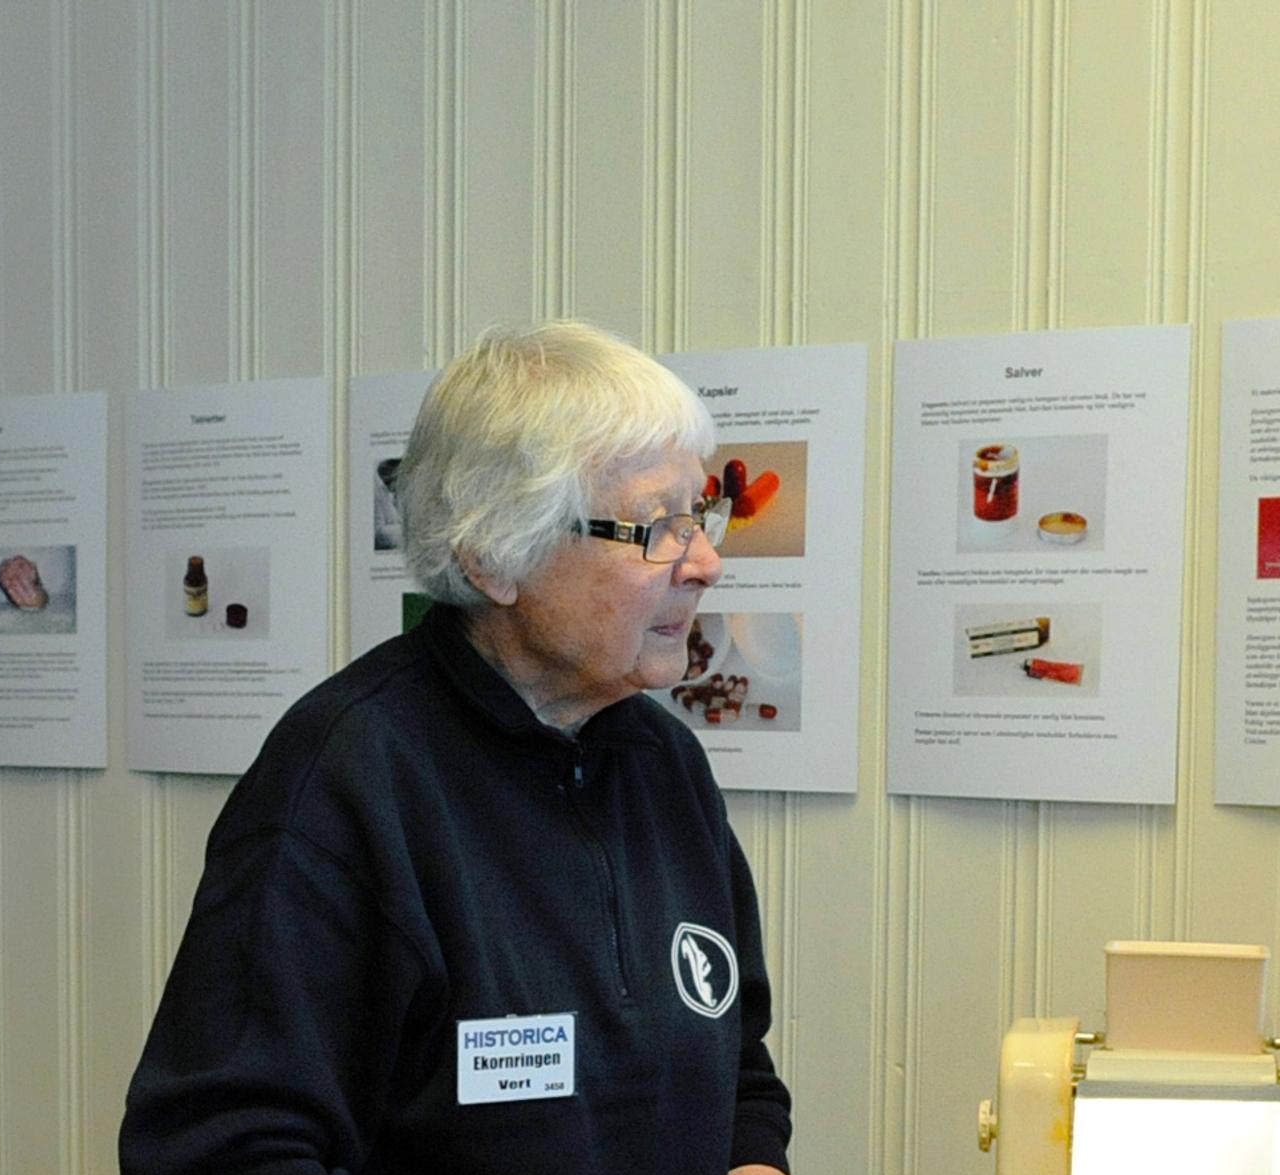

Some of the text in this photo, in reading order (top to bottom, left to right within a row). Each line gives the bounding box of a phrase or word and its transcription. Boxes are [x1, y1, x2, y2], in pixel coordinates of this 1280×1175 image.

[1005, 367, 1043, 379] Salver
[464, 1026, 568, 1049] HISTORICA
[473, 1053, 561, 1072] Ekornringen
[498, 1078, 531, 1090] Vert
